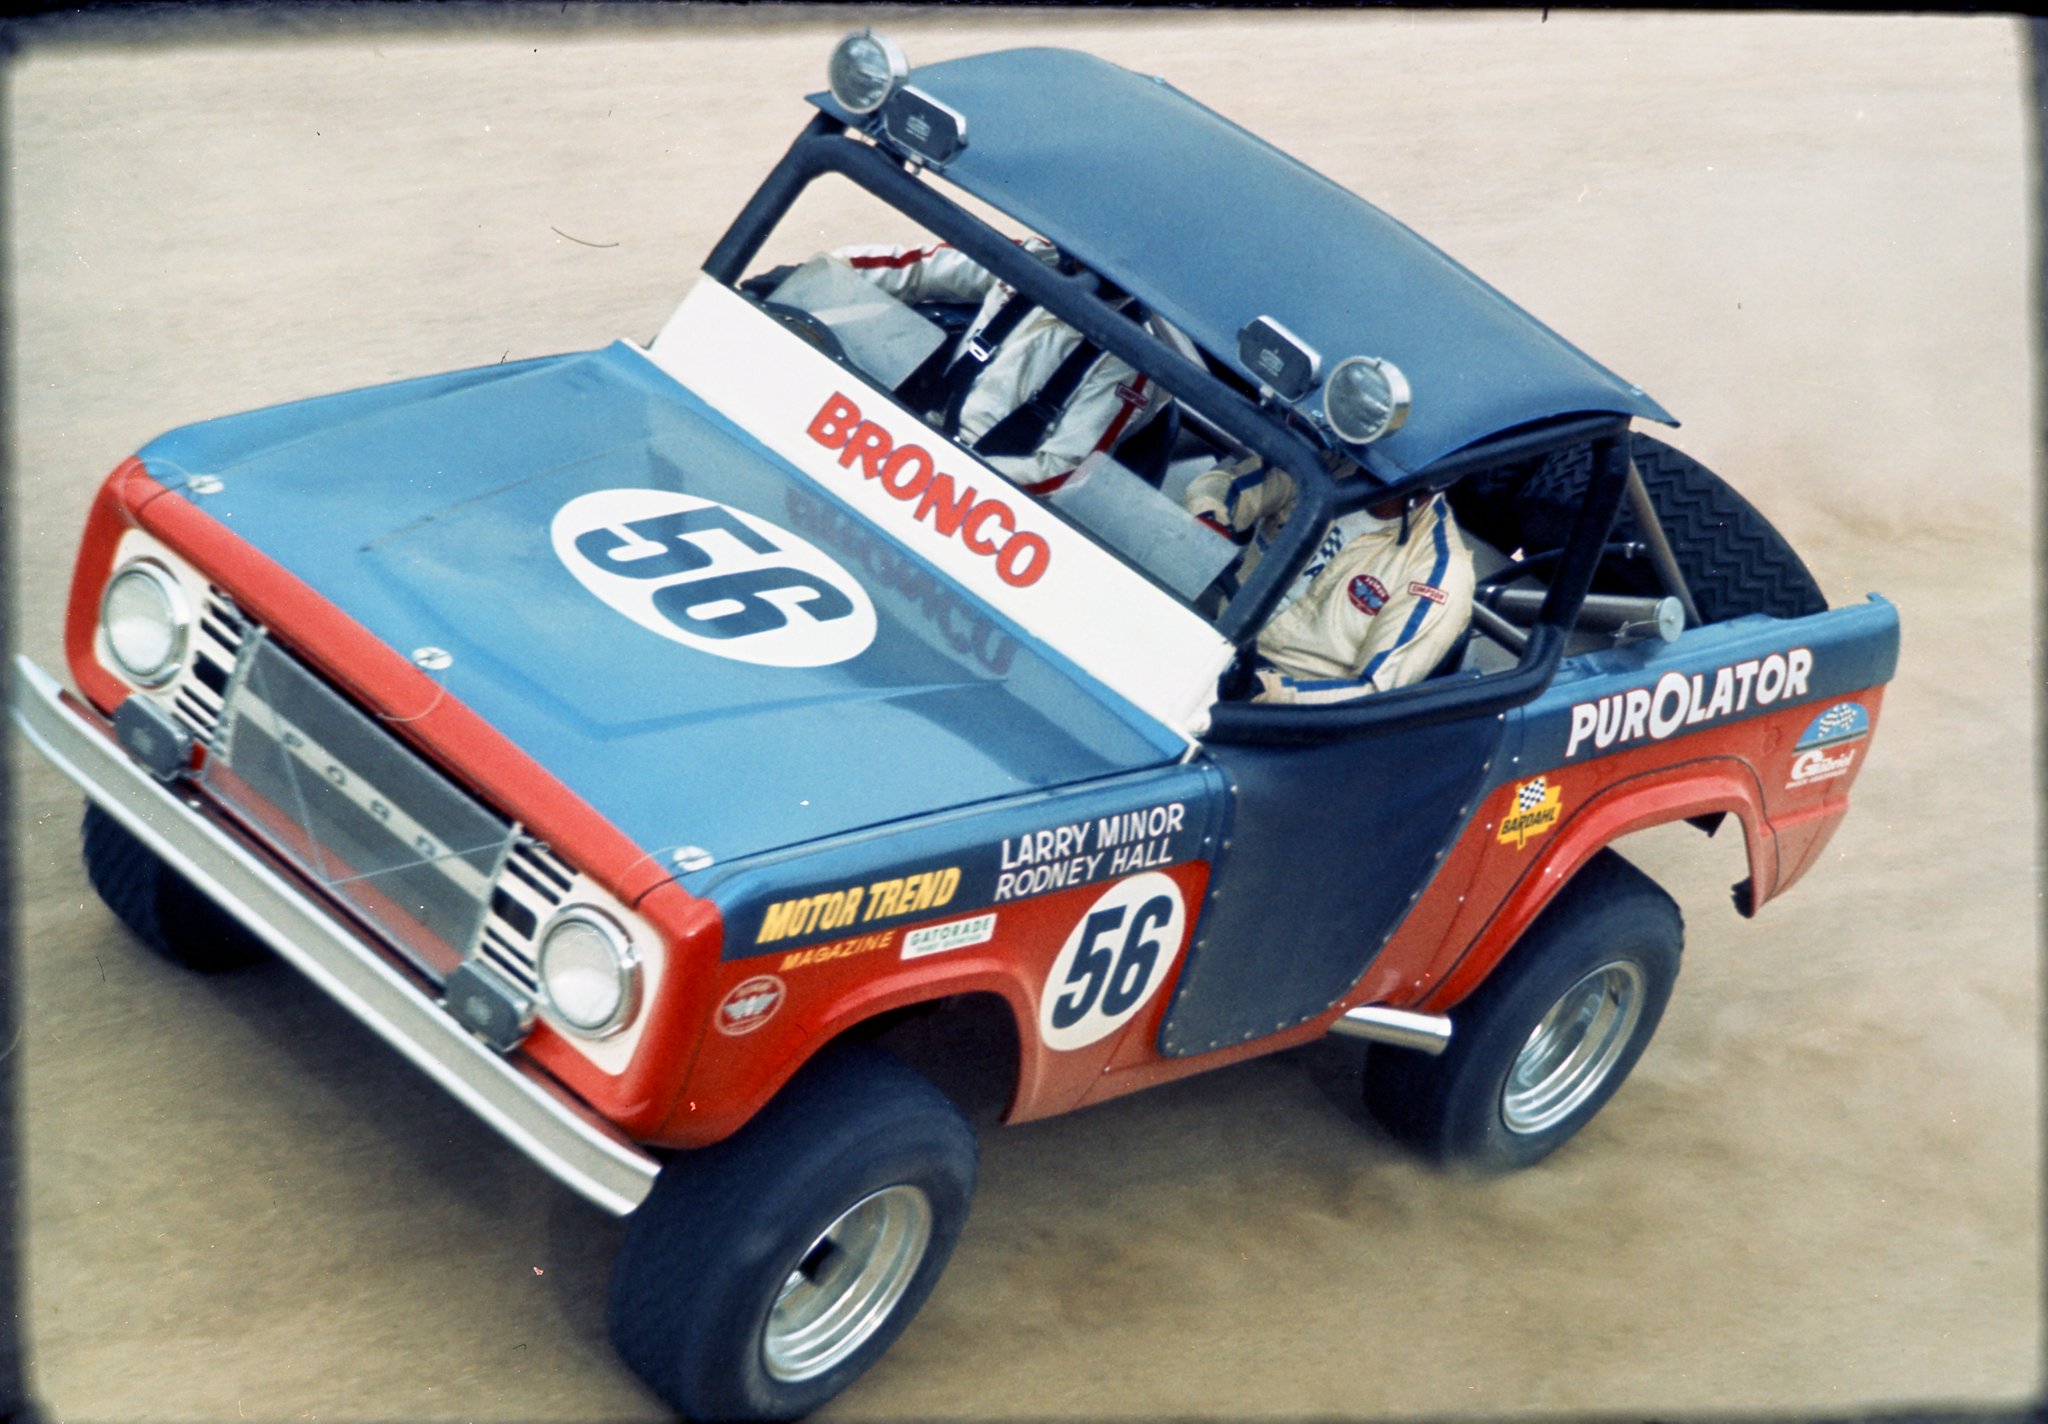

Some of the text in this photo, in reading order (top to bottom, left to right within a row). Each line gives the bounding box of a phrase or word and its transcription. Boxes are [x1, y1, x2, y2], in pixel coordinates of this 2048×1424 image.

[805, 390, 1051, 588] BRONCO
[574, 505, 855, 640] 56
[1565, 647, 1814, 758] PUROLATOR
[1001, 803, 1185, 872] LARRY MINOR
[1500, 807, 1556, 835] BARDAHL
[755, 866, 961, 944] MOTOR TREND
[994, 837, 1175, 902] RODNEY HALL
[778, 930, 897, 971] MAGAZINE
[911, 916, 993, 946] GATORADE
[1051, 895, 1174, 1030] 56
